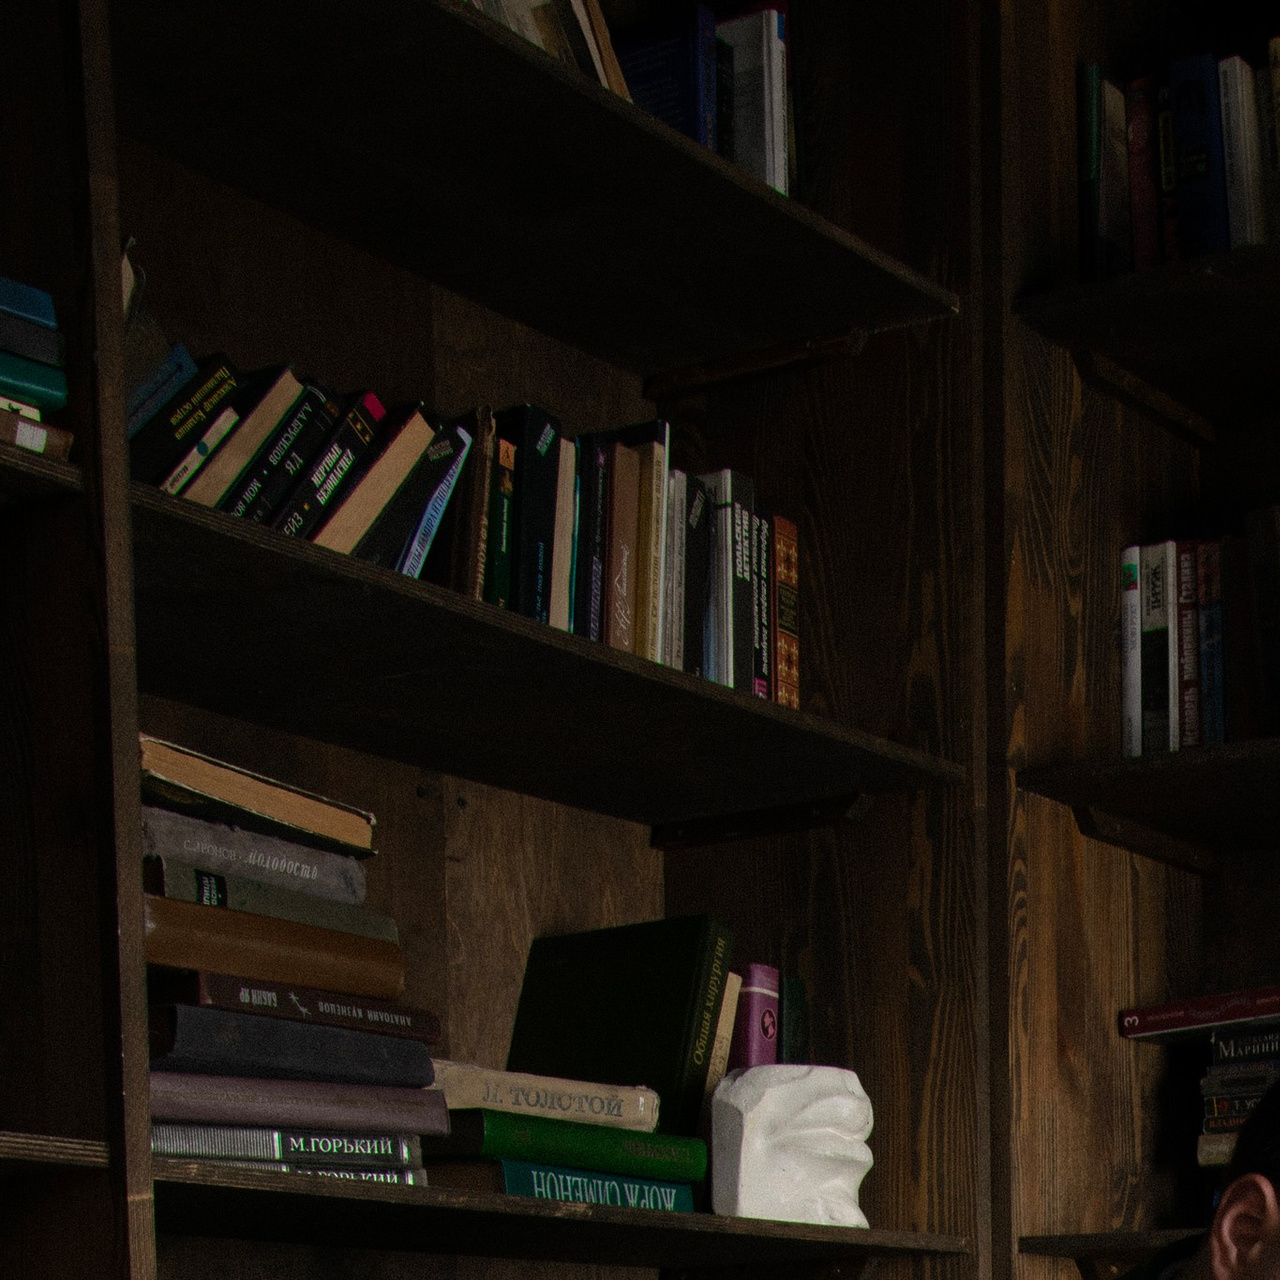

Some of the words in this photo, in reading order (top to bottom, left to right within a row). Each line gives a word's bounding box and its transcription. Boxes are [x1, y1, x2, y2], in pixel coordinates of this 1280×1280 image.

[701, 936, 729, 1008] хирургия
[316, 1000, 363, 1019] КУЗНЕЦОВ
[365, 1008, 412, 1027] АНАТОЛИЙ
[691, 1011, 714, 1065] Общая
[509, 1087, 624, 1116] ТОЛСТОЙ
[289, 1136, 393, 1154] М.ГОРЬКИЙ
[529, 1171, 621, 1206] СИМЕНОН
